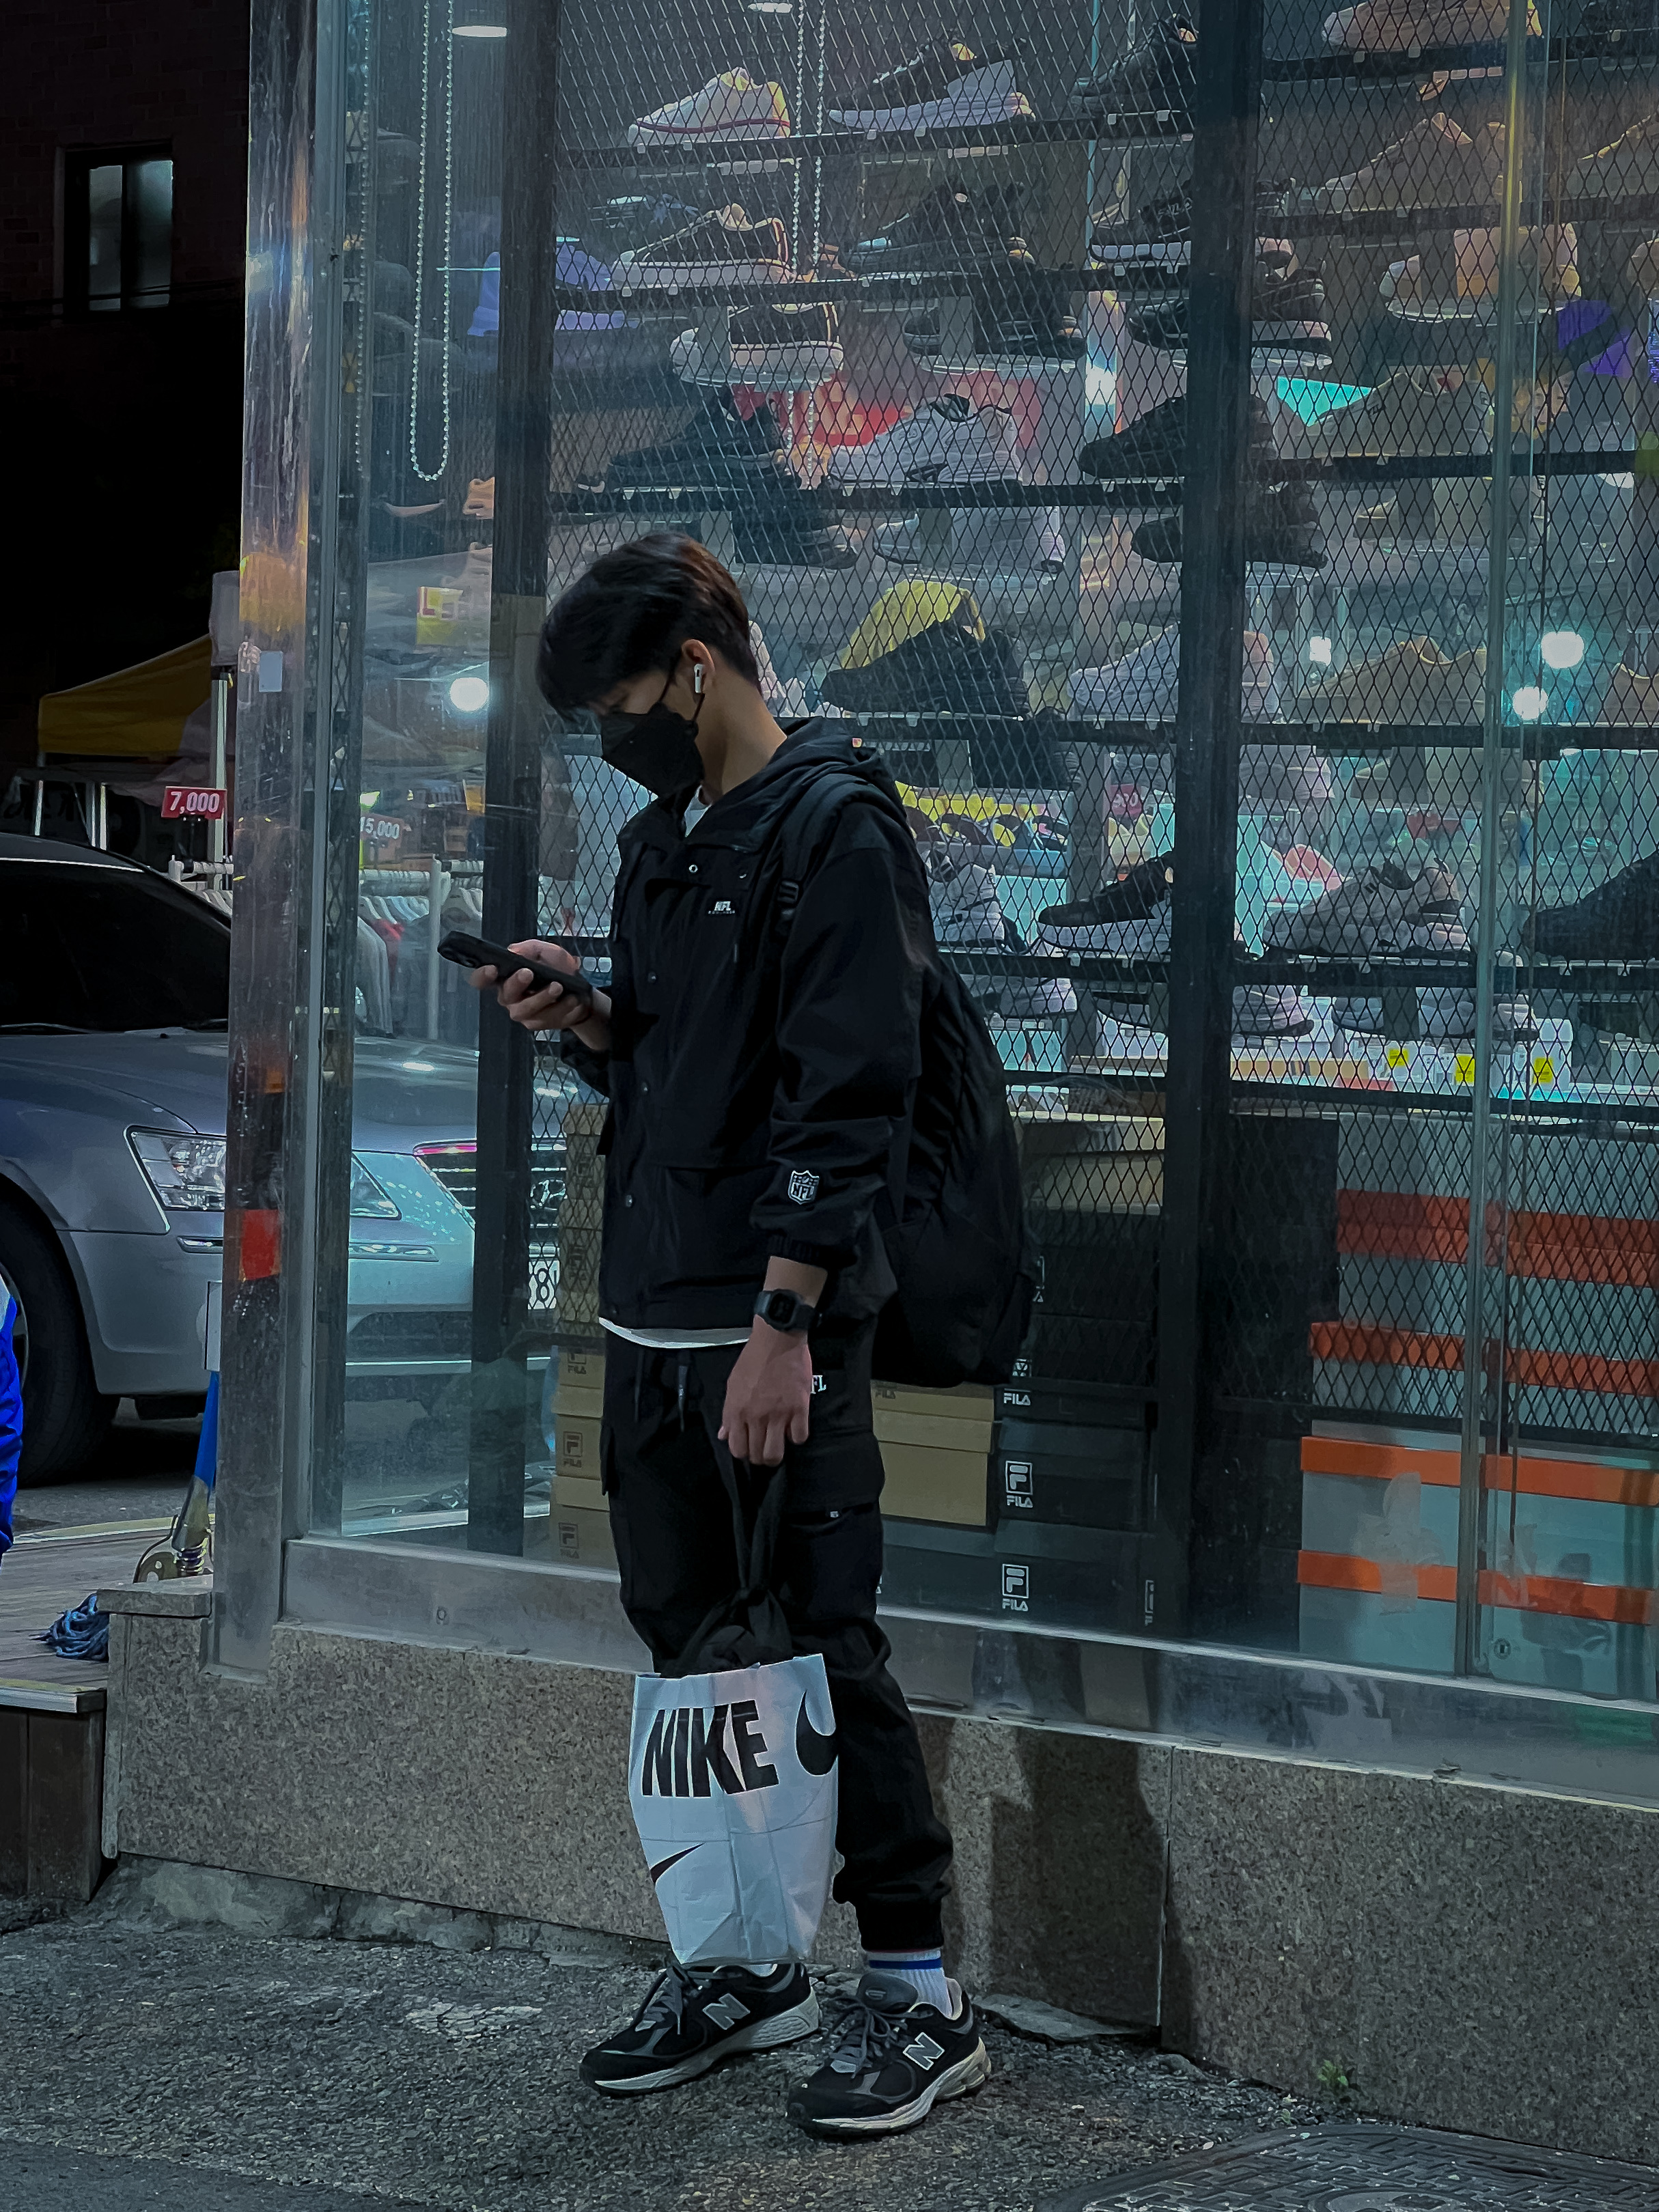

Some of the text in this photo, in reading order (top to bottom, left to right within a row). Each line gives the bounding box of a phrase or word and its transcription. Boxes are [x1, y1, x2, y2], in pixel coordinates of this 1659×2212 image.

[170, 791, 220, 814] 7,000
[1003, 1392, 1031, 1405] FILA
[1006, 1495, 1033, 1509] FILA
[1002, 1598, 1029, 1612] FILA
[642, 1699, 779, 1797] NIKE
